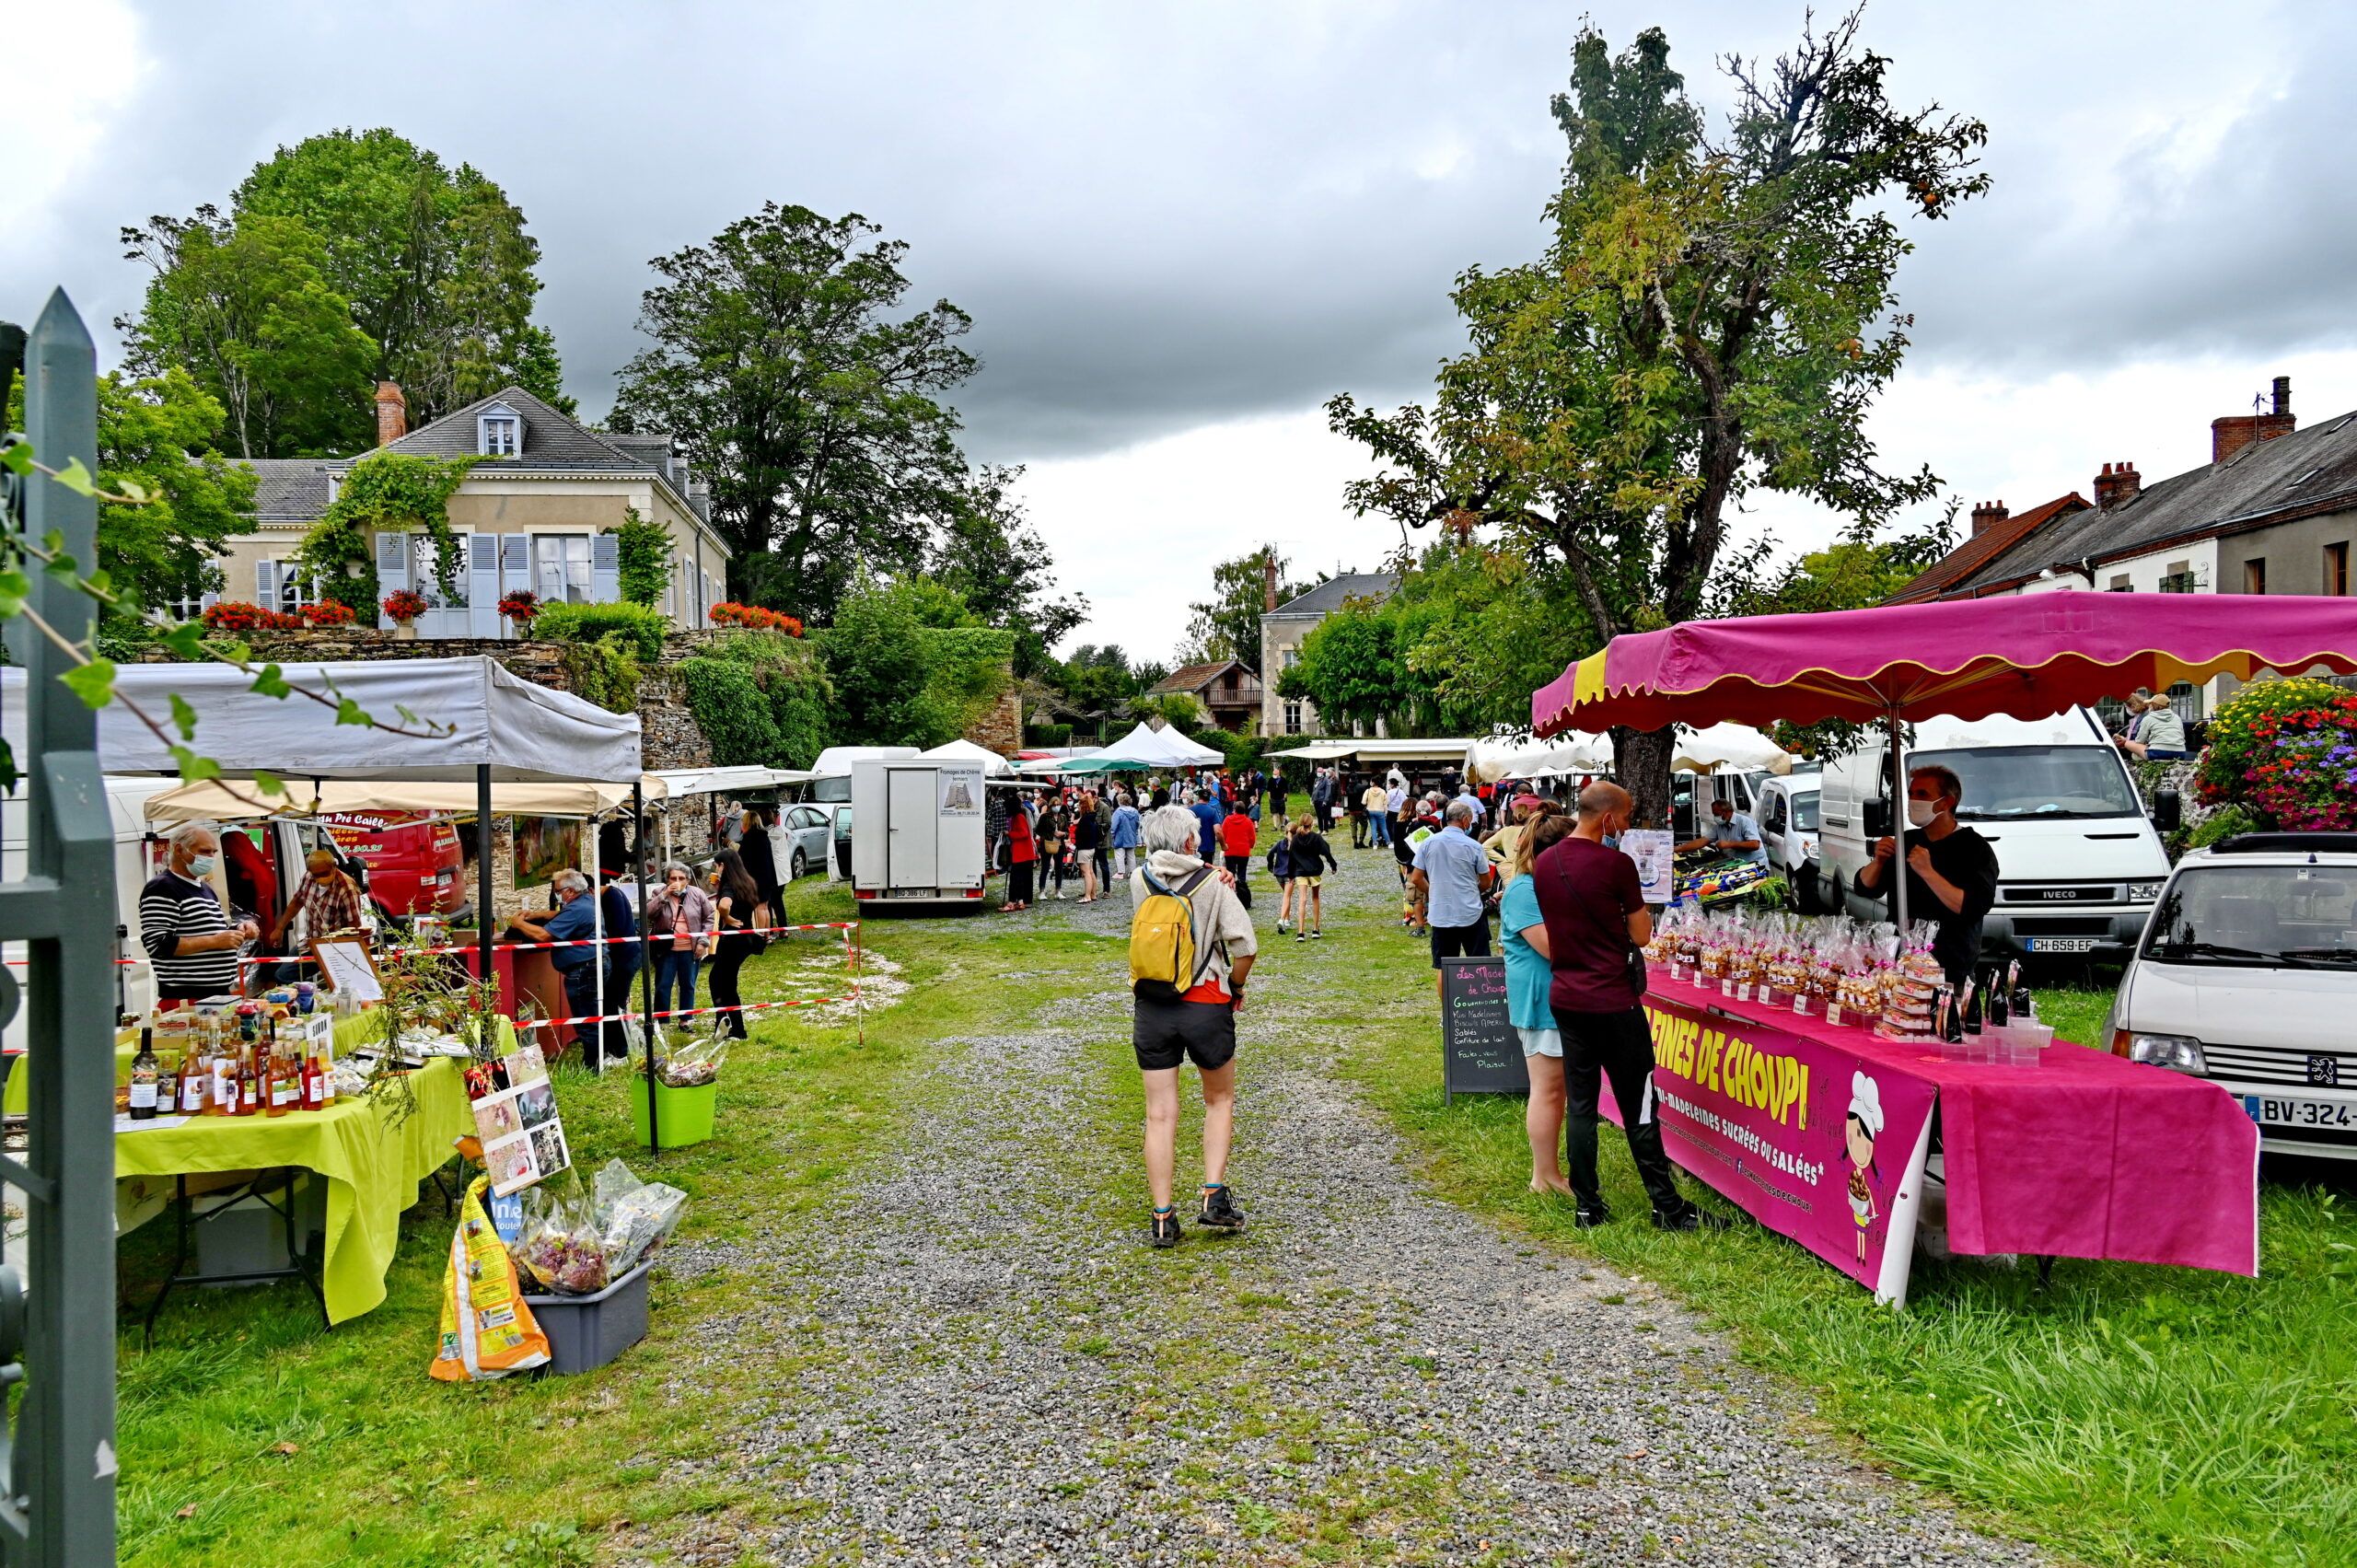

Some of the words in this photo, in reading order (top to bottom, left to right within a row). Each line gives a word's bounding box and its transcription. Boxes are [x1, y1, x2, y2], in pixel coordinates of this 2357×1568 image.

[335, 813, 352, 823] Pré
[2033, 940, 2092, 951] CH-659-EF
[1457, 967, 1474, 979] Les
[1476, 966, 1505, 983] Madel
[1469, 984, 1478, 994] de
[1481, 983, 1507, 995] Choup
[1455, 1028, 1477, 1037] Sablés
[1696, 1028, 1726, 1093] DE
[1723, 1038, 1809, 1131] CHOUPI
